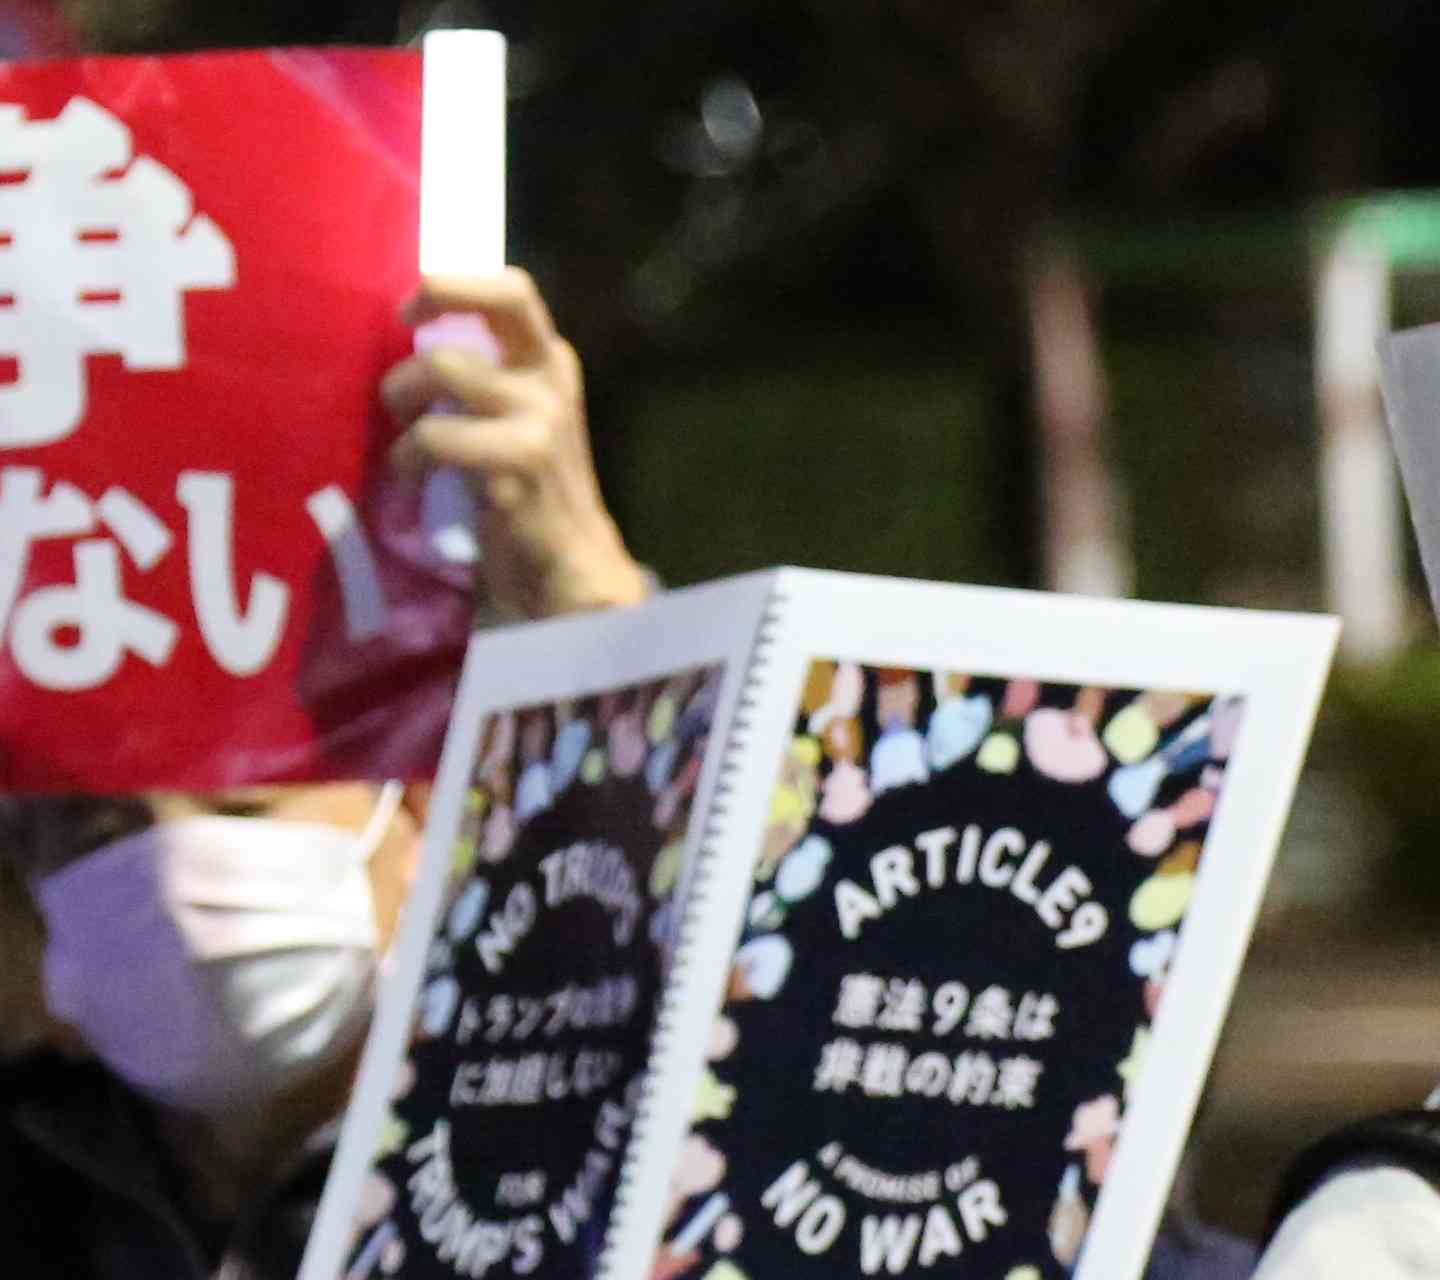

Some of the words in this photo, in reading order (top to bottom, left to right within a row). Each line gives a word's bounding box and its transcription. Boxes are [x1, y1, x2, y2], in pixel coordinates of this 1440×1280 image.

[475, 881, 537, 973] NO
[760, 1158, 848, 1256] NO
[860, 1178, 1010, 1276] WAR
